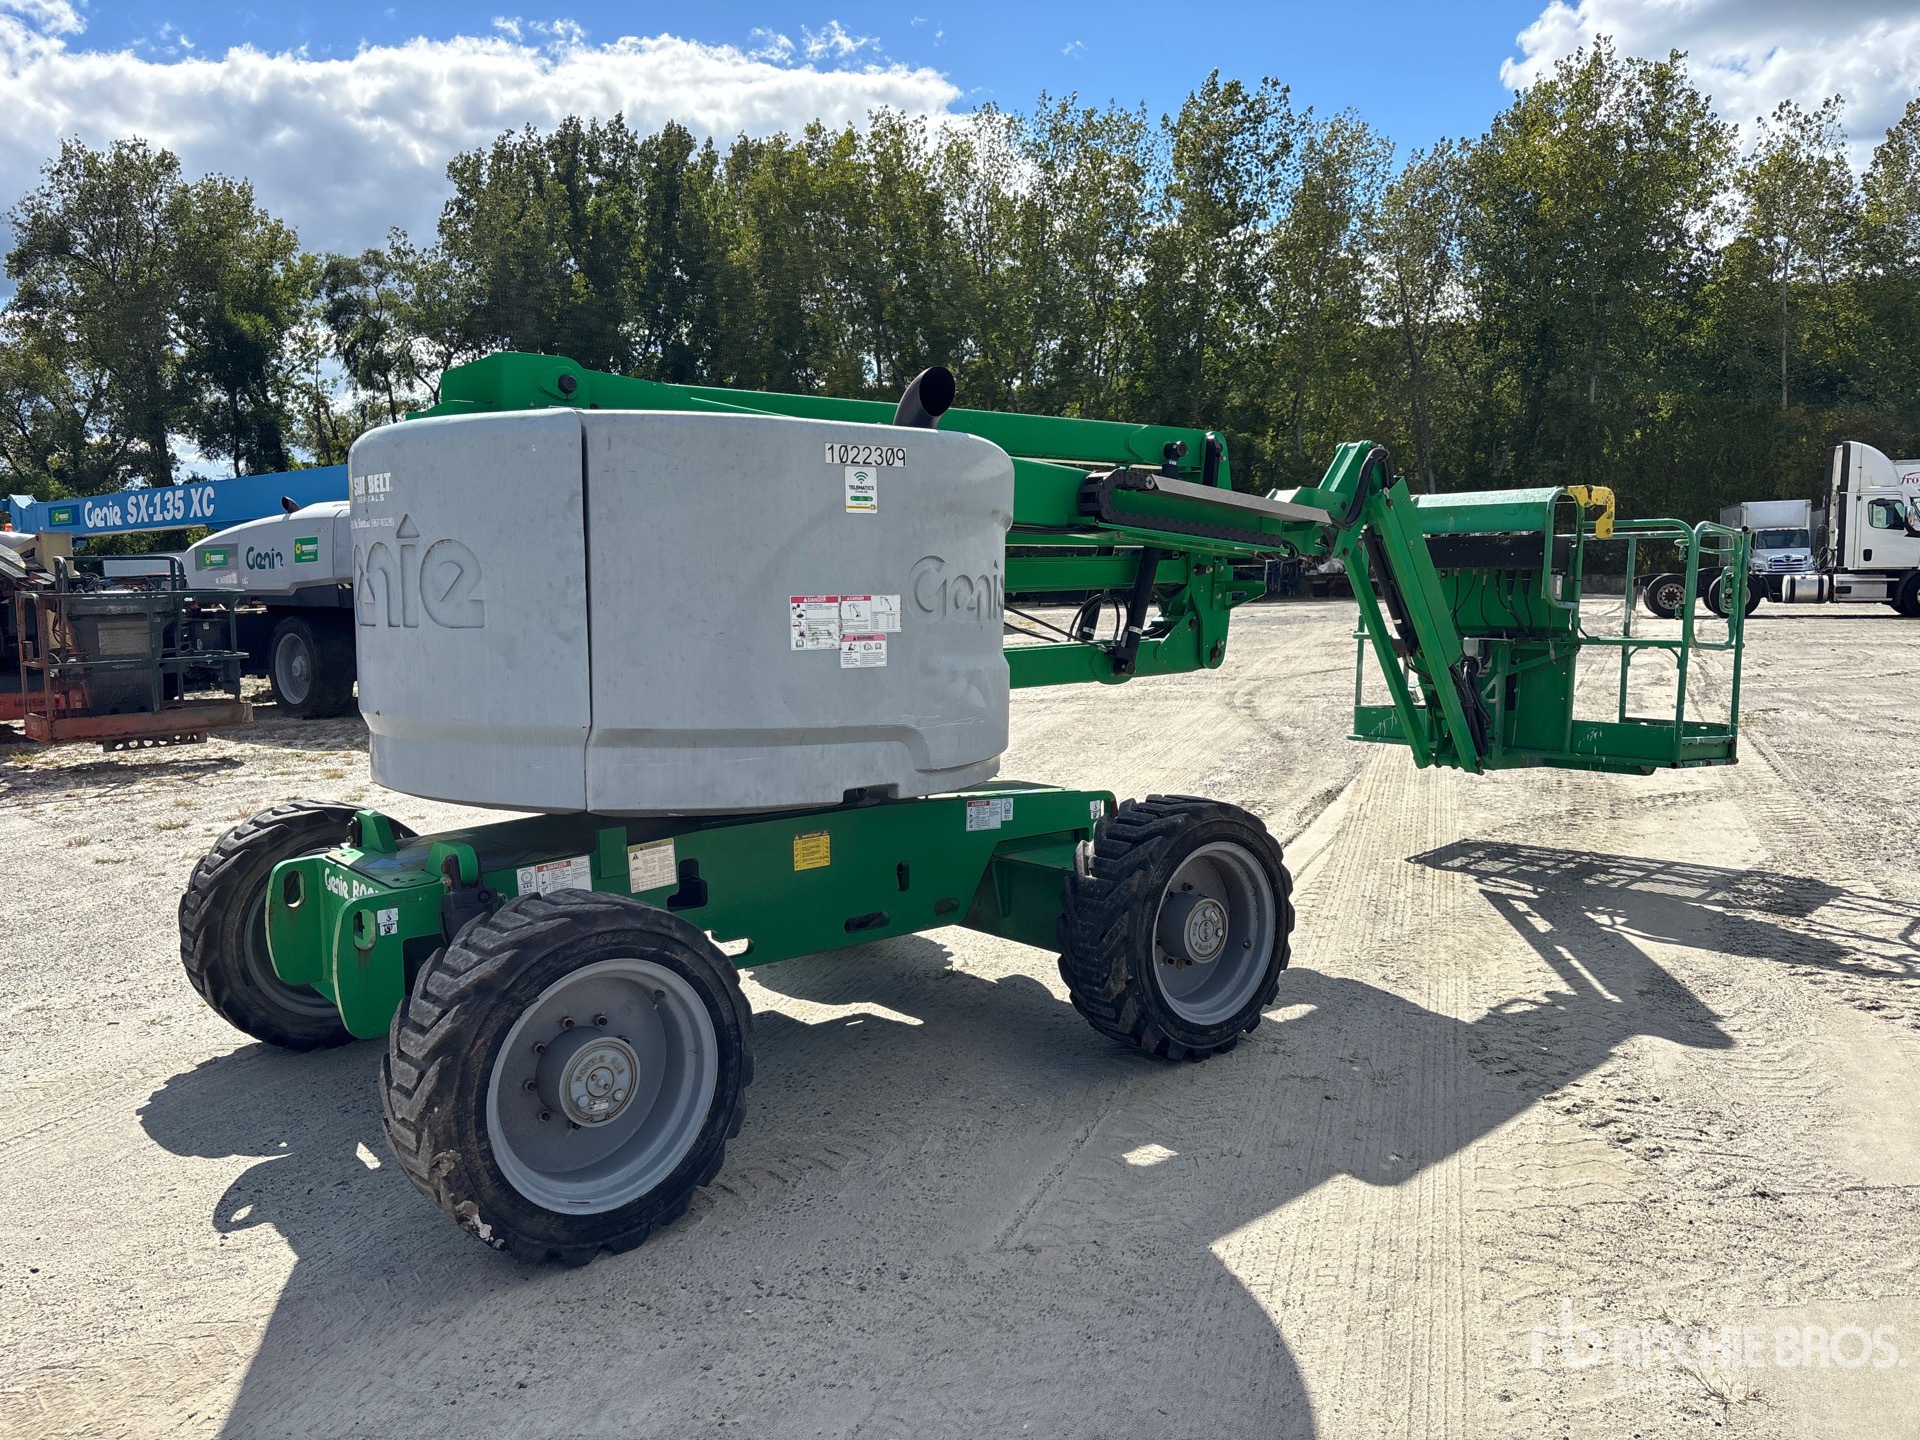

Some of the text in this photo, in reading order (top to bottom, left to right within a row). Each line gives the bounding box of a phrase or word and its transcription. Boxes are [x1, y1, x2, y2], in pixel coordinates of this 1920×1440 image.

[827, 444, 906, 467] 1022309
[84, 485, 215, 529] Genie SX-135 XC
[547, 860, 567, 870] DANGER
[324, 867, 380, 900] Genie BOO
